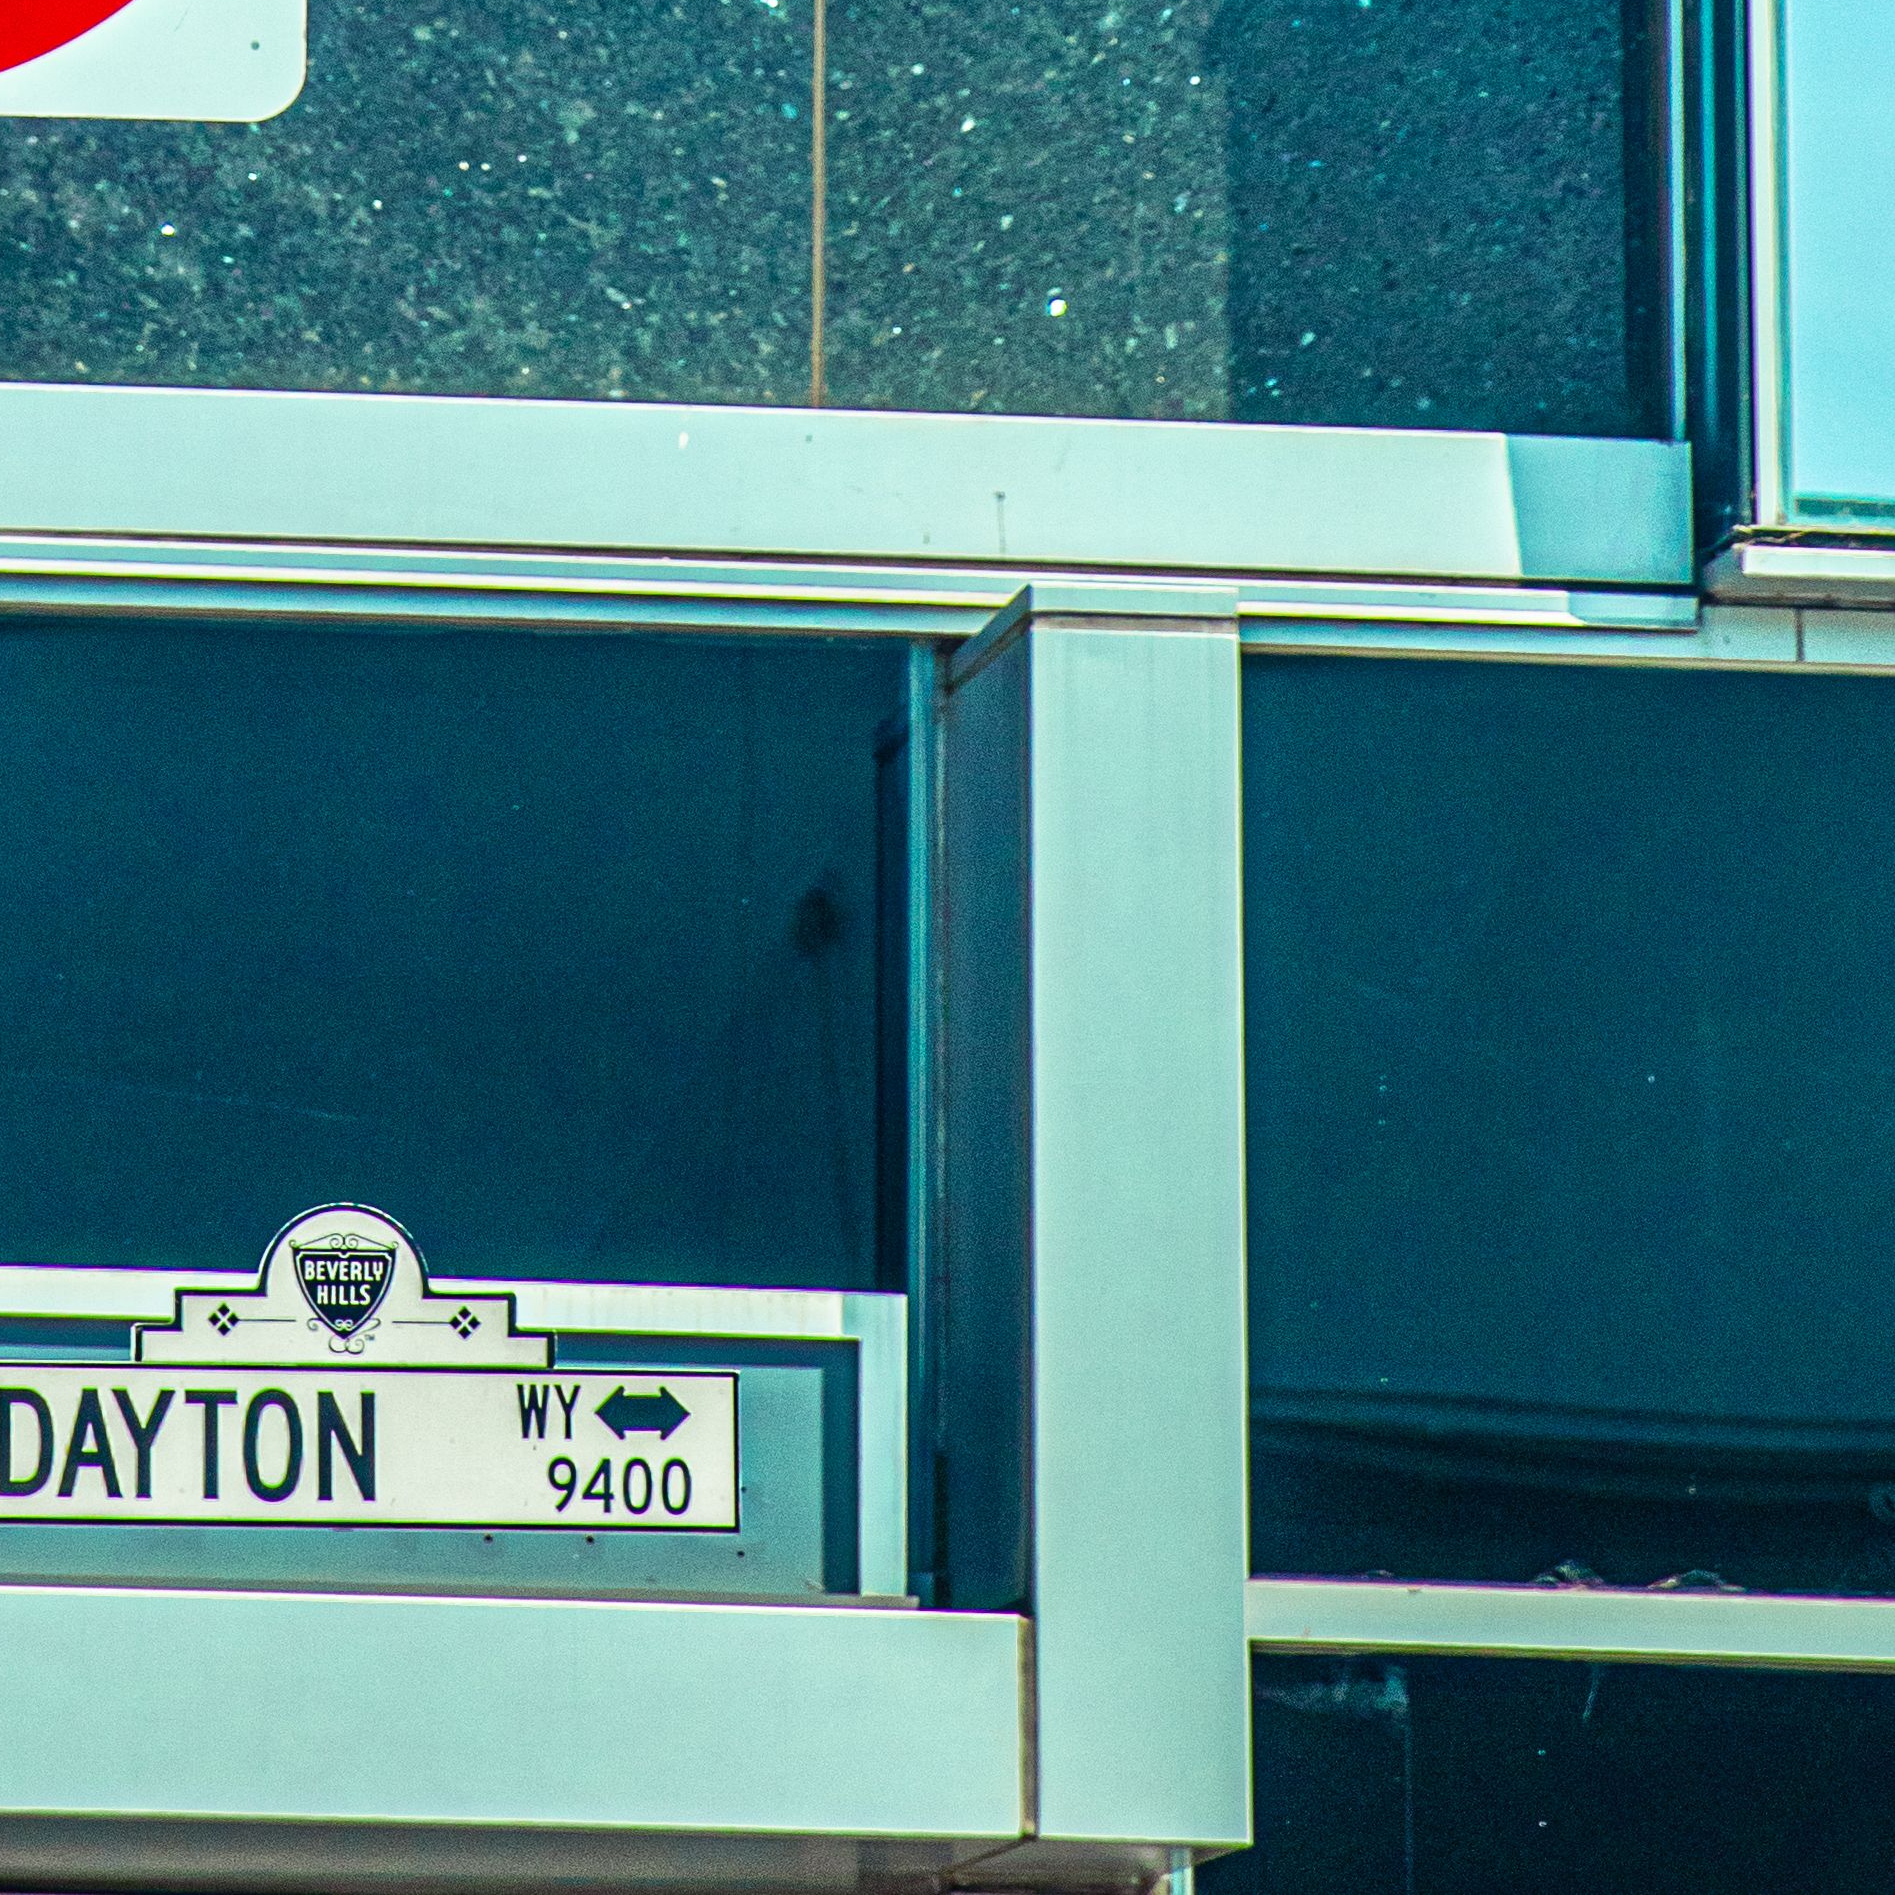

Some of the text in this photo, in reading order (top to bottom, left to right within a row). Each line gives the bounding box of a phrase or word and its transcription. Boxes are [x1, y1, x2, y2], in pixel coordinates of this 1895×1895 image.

[304, 1260, 383, 1281] BEVERLY
[316, 1284, 371, 1305] HILLS
[516, 1383, 582, 1441] WY
[547, 1456, 693, 1515] 9400
